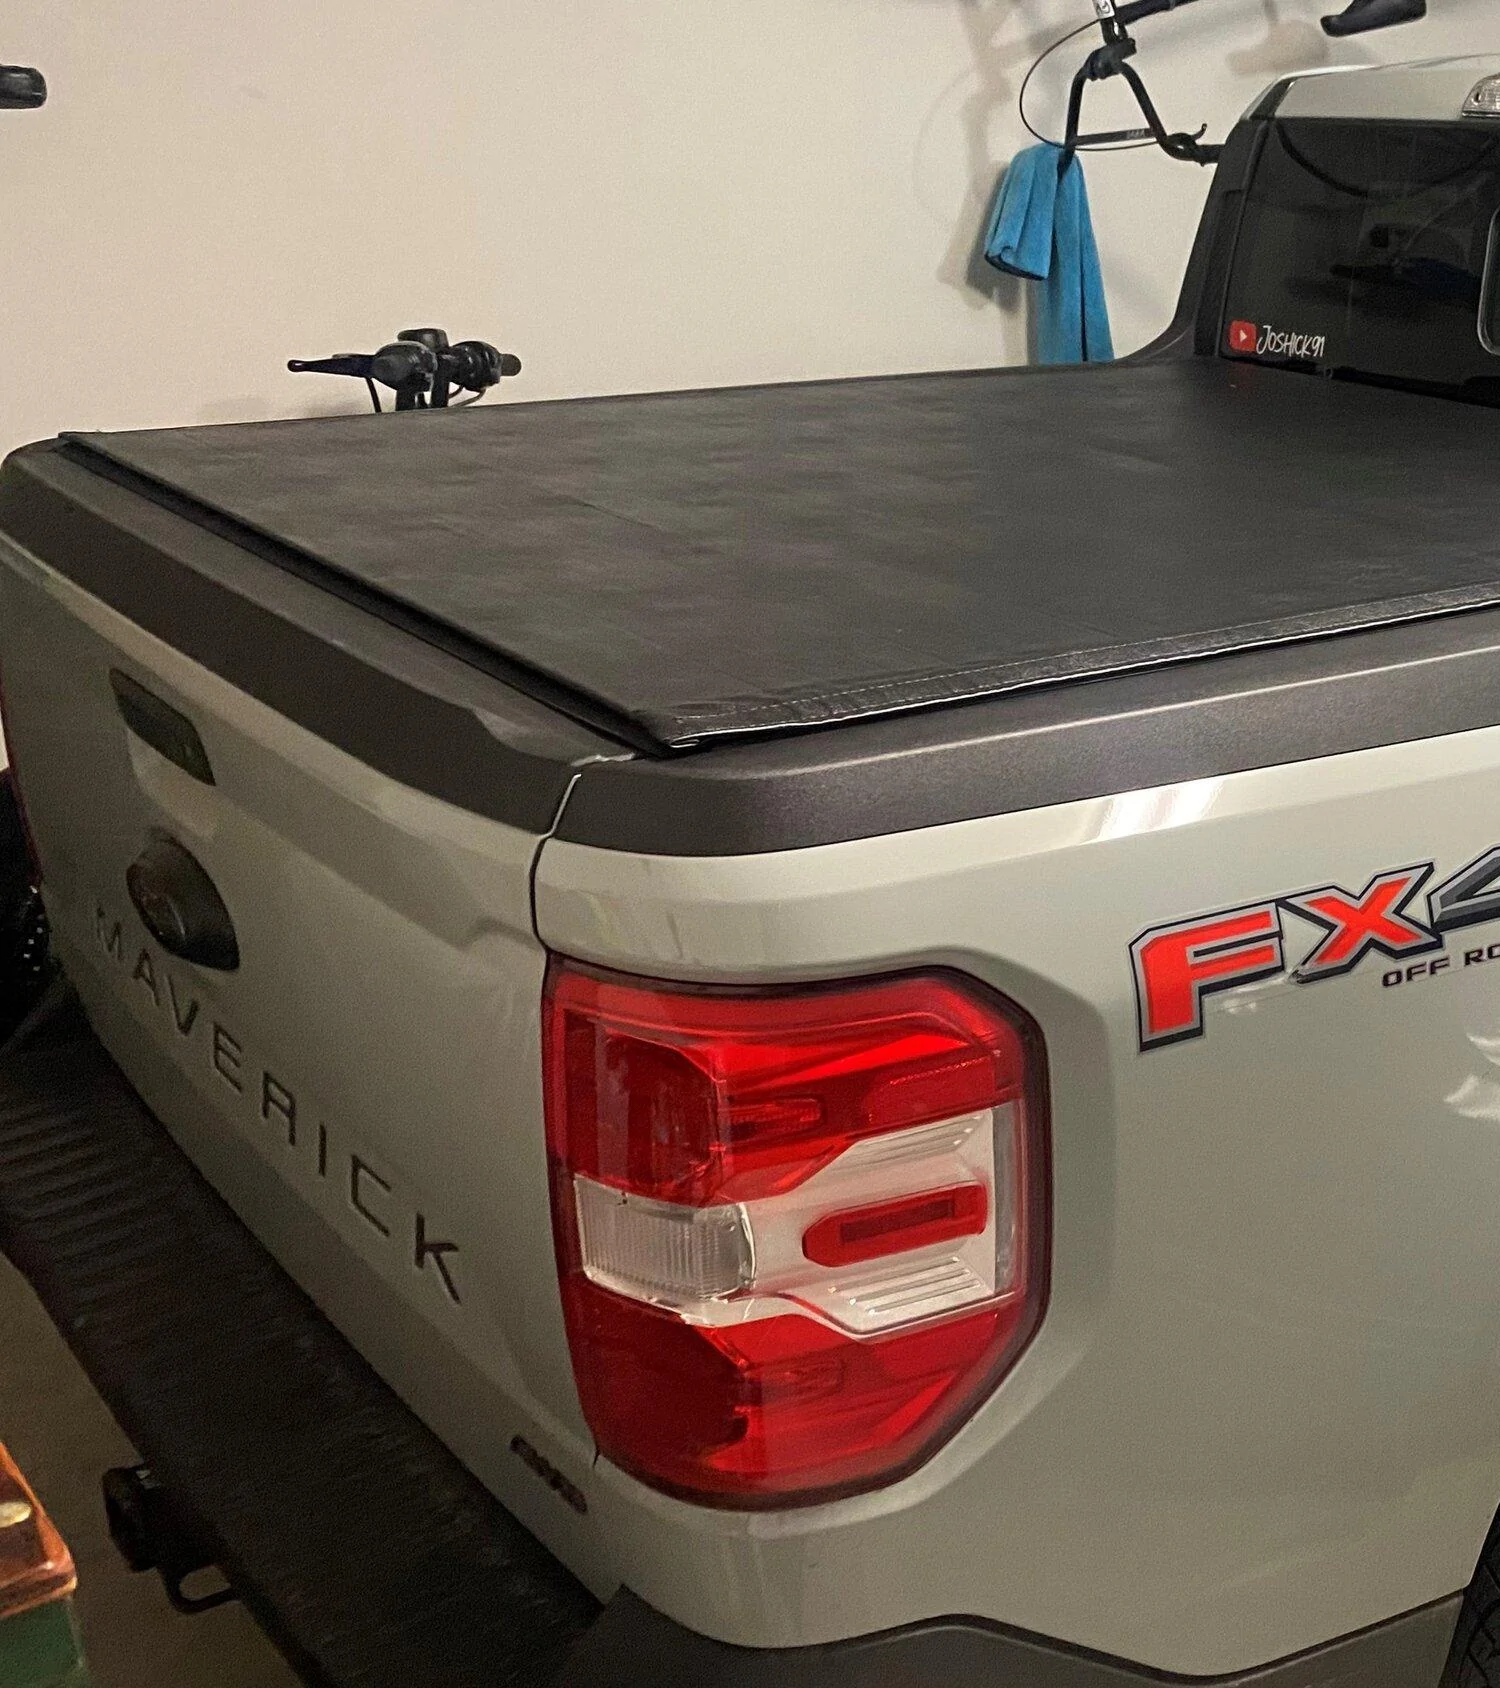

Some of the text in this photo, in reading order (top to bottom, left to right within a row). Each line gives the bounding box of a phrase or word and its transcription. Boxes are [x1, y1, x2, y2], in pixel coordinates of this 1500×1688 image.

[1256, 325, 1326, 358] JOSHICK91
[1382, 957, 1450, 988] OFF
[97, 905, 462, 1304] MAVERICK
